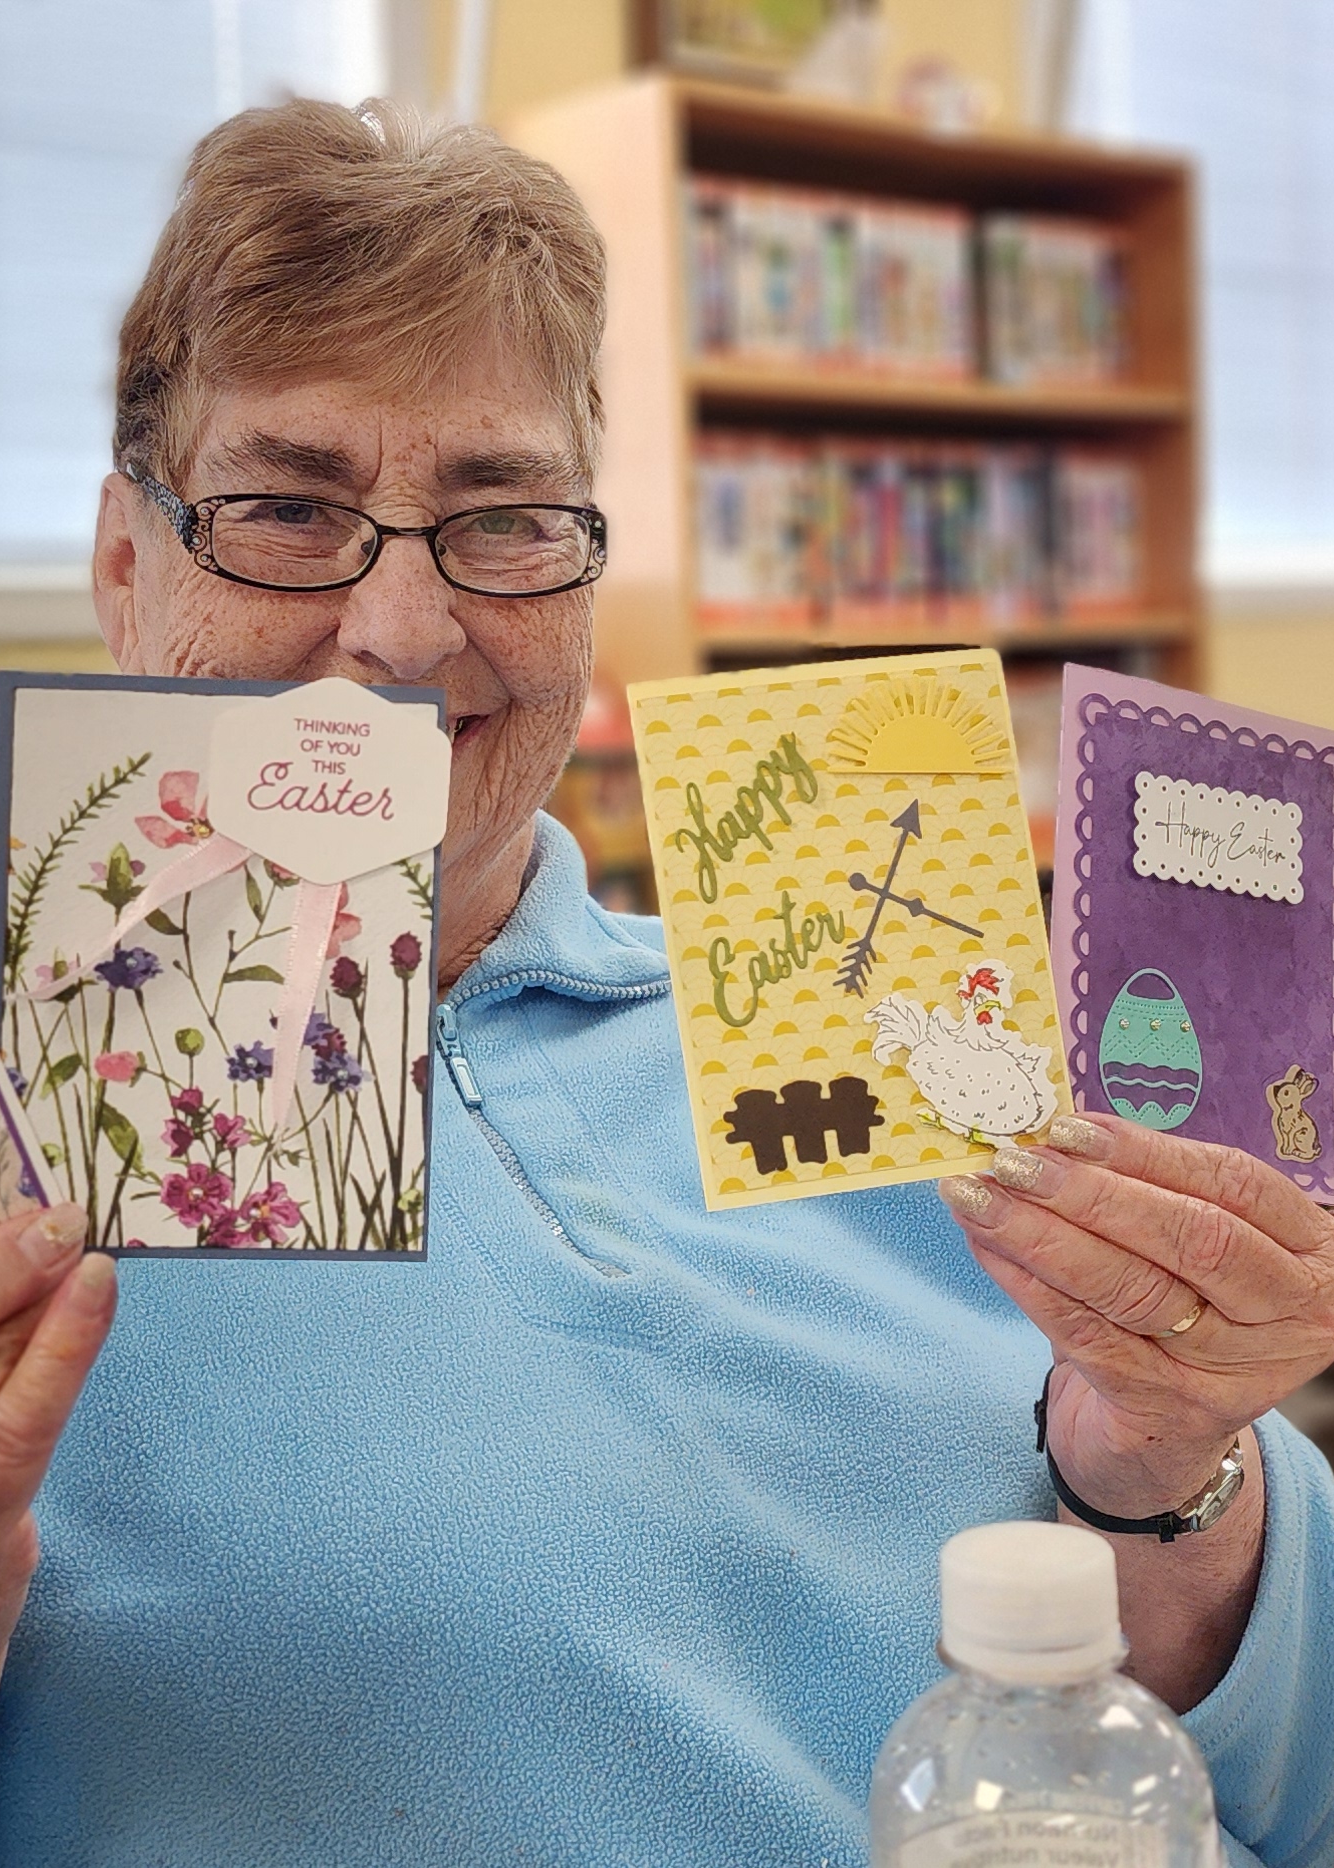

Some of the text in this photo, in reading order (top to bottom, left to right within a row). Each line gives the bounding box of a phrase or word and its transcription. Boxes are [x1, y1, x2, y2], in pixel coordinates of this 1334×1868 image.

[293, 717, 370, 738] THINKING
[300, 739, 361, 757] OF YOU
[247, 760, 395, 822] Easter
[311, 758, 347, 775] THIS
[676, 731, 818, 903] Happy
[1155, 802, 1286, 868] Happy Easter
[708, 890, 846, 1028] Easter
